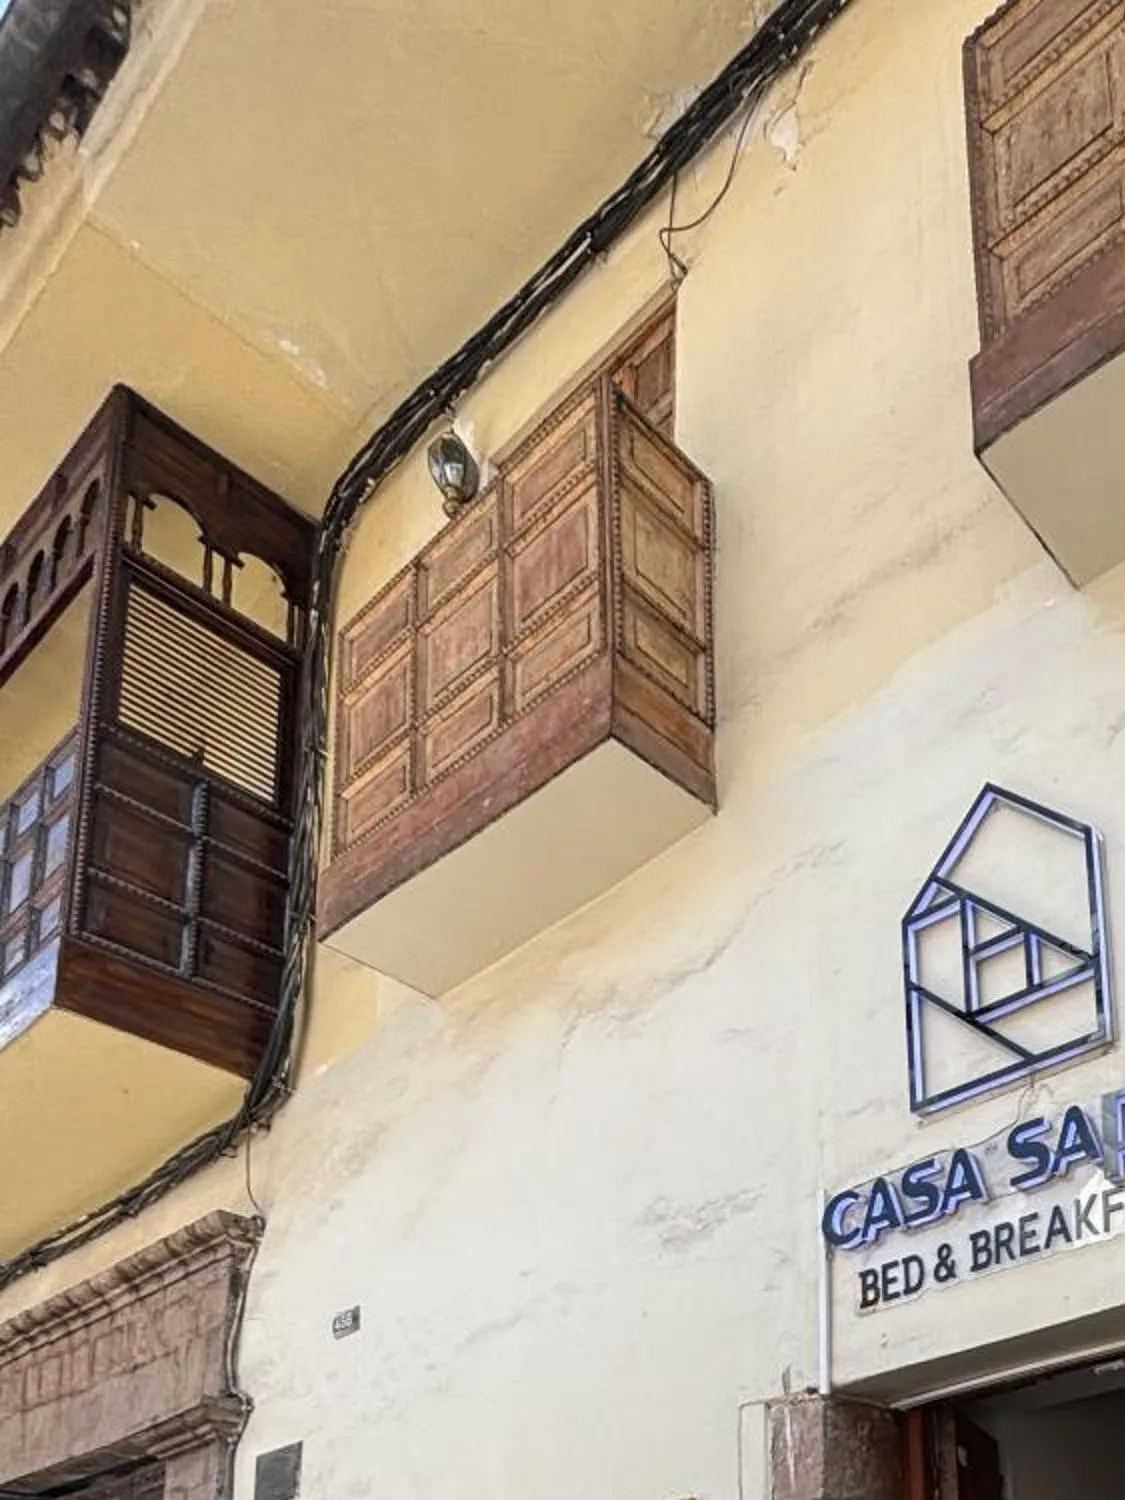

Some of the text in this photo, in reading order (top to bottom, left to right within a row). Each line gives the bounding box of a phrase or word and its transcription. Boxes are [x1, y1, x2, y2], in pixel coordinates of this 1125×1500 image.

[821, 1147, 988, 1250] CASA
[858, 1253, 926, 1309] BED
[933, 1243, 957, 1283] &
